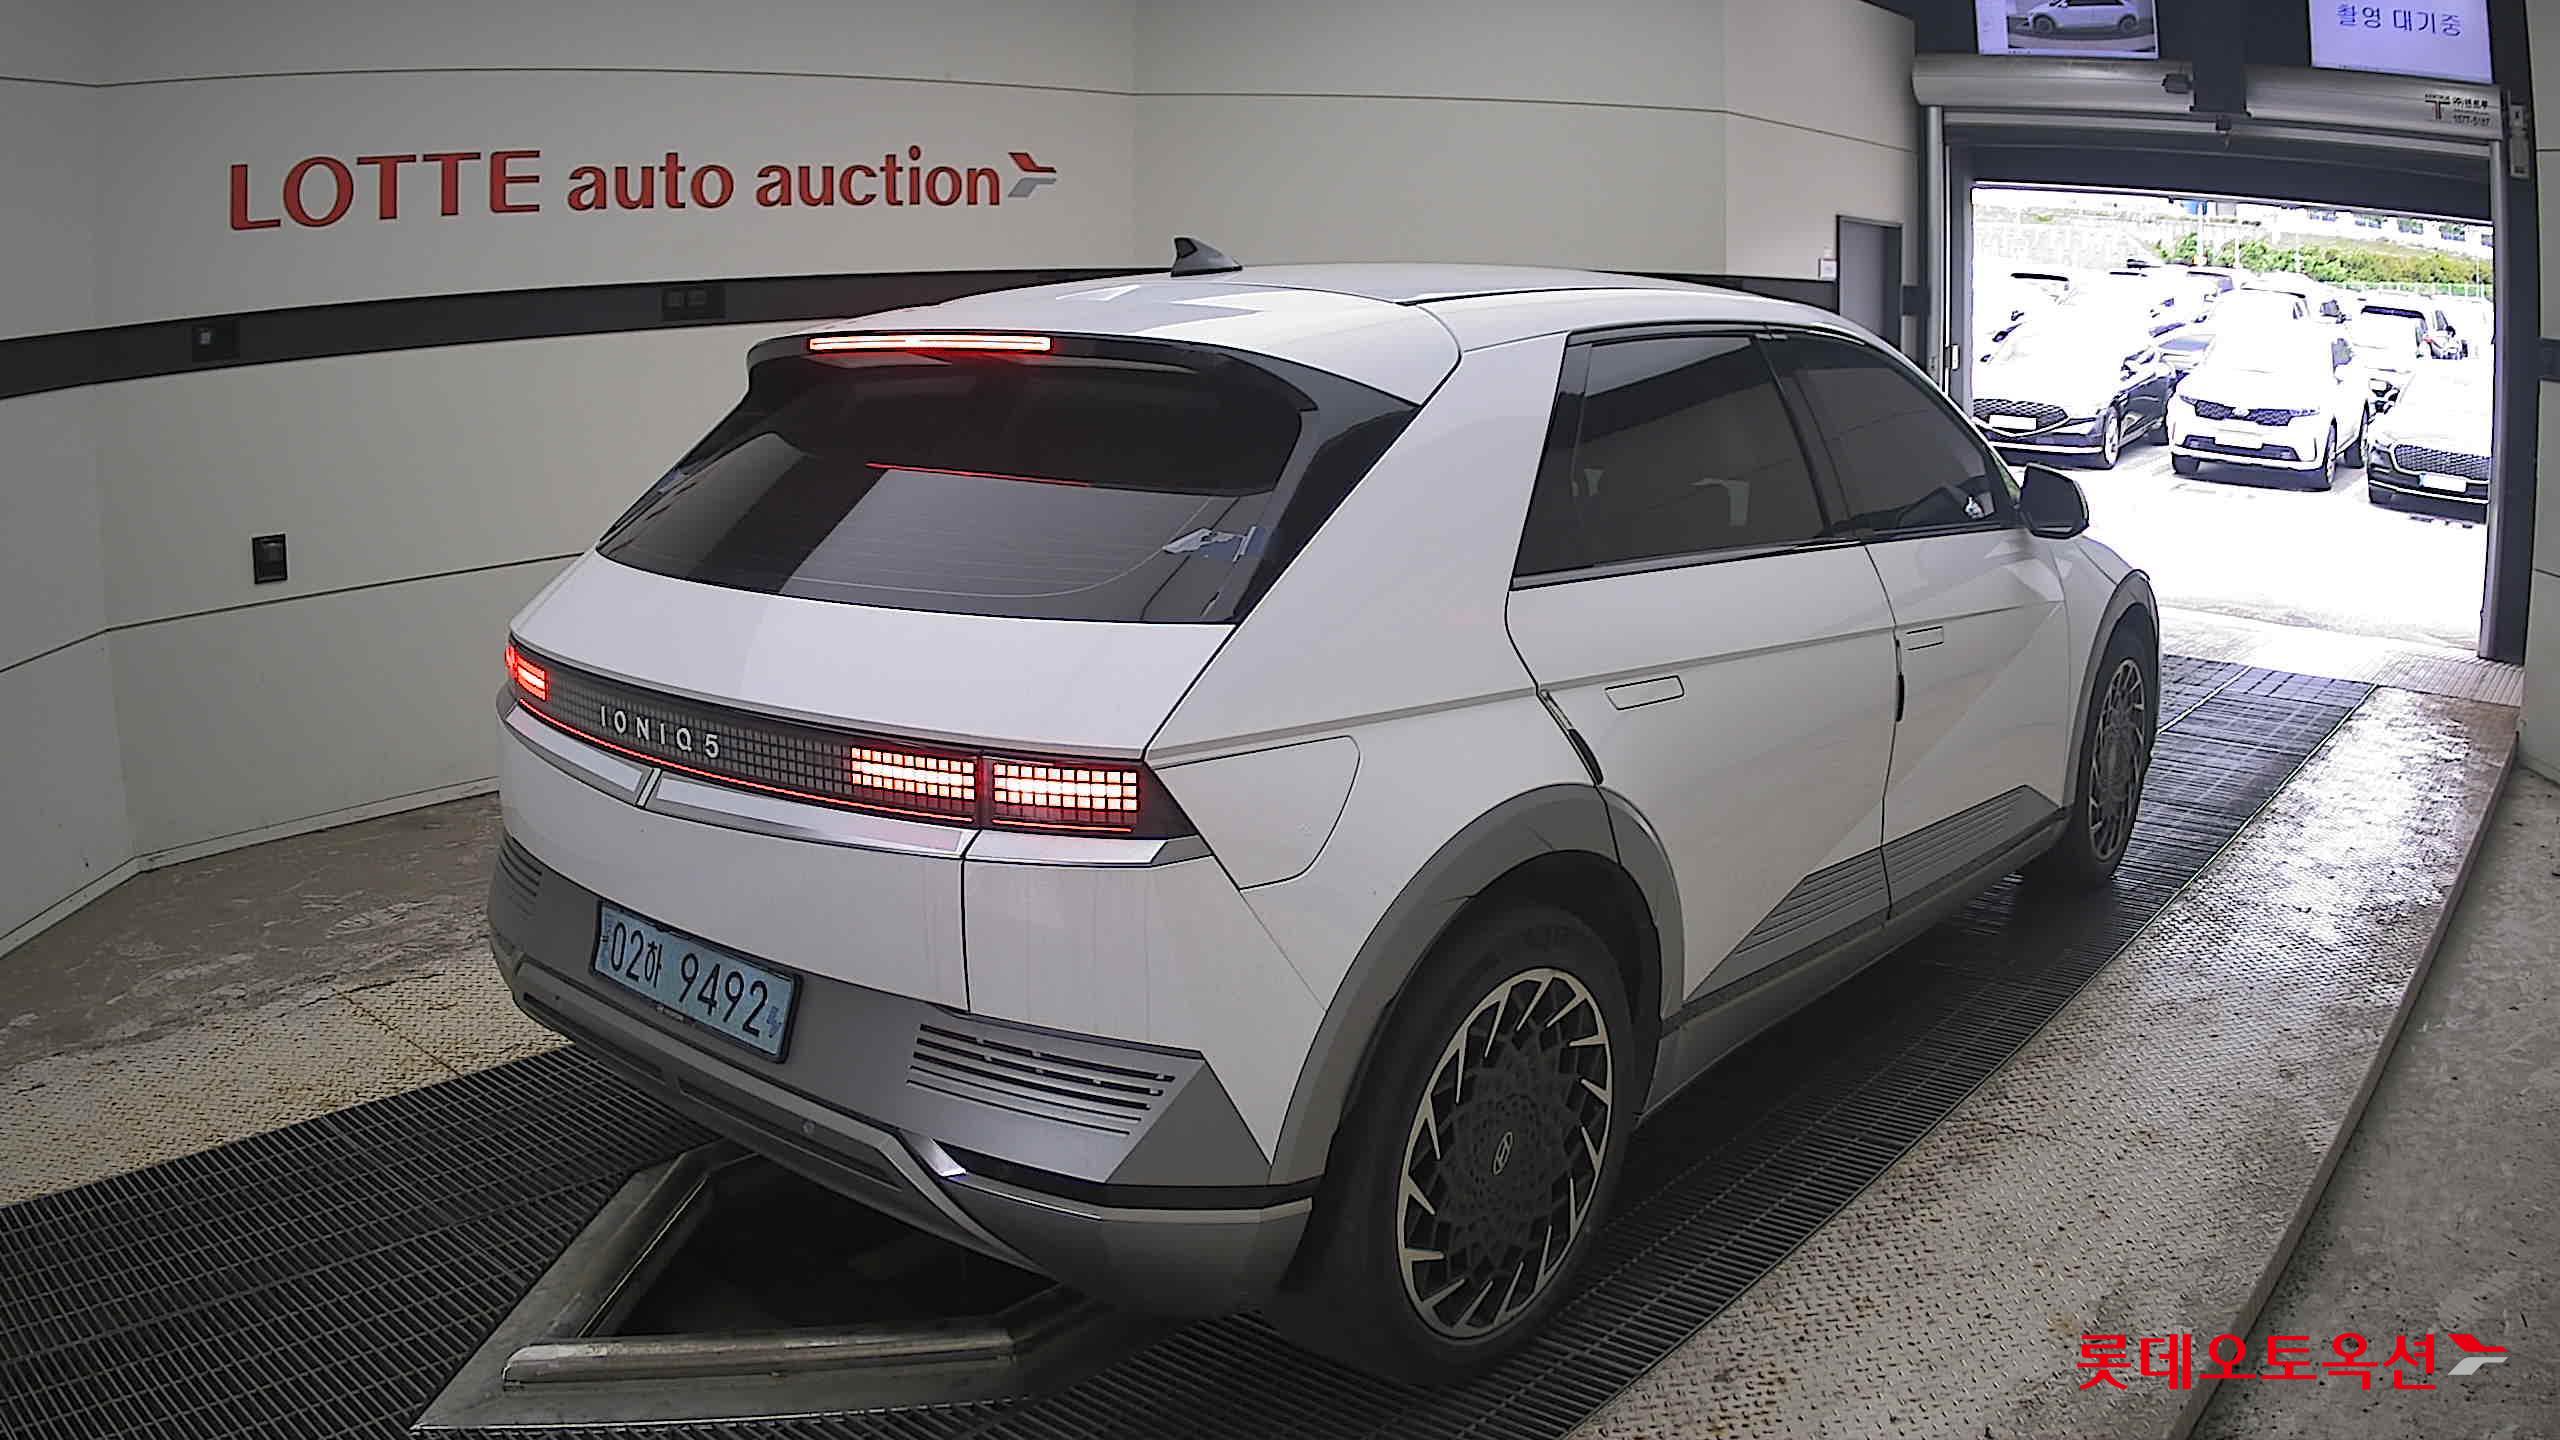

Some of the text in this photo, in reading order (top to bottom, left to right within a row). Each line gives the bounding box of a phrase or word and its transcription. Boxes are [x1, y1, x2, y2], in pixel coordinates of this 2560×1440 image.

[2337, 4, 2462, 37] 촬영 대기중
[230, 145, 1001, 231] LOTTE auto auction
[600, 705, 720, 759] IONIQ 5
[610, 922, 768, 1038] 02하 9492
